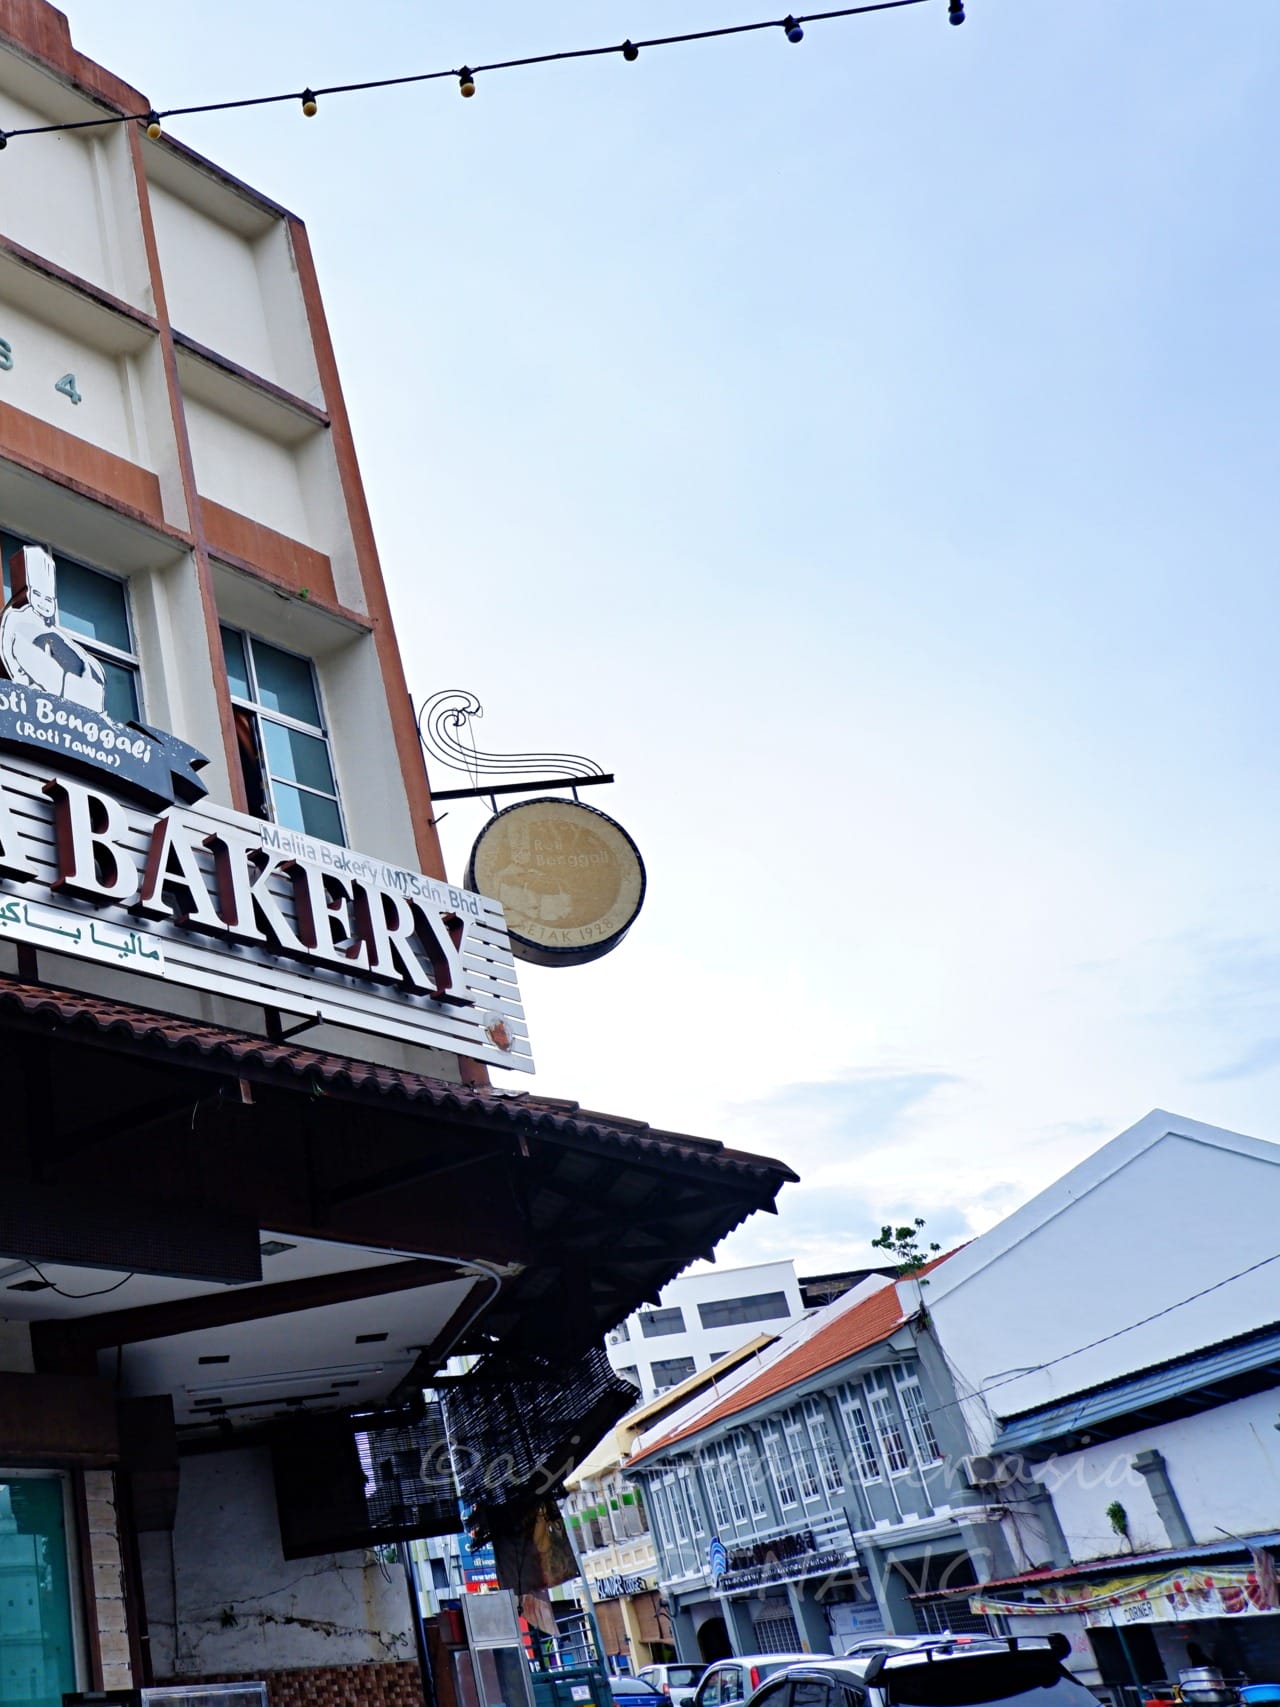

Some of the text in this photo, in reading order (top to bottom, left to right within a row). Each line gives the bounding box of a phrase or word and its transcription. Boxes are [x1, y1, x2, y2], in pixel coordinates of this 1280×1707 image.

[16, 720, 120, 767] (Roti Tawar)
[35, 698, 151, 763] Benggali
[261, 825, 317, 860] Maliia
[321, 849, 378, 883] Bakery
[411, 874, 447, 905] Sdn.
[42, 775, 477, 1007] BAKERY
[90, 923, 160, 961] ماليا
[579, 918, 614, 940] 1928
[1124, 1601, 1154, 1623] CORNER
